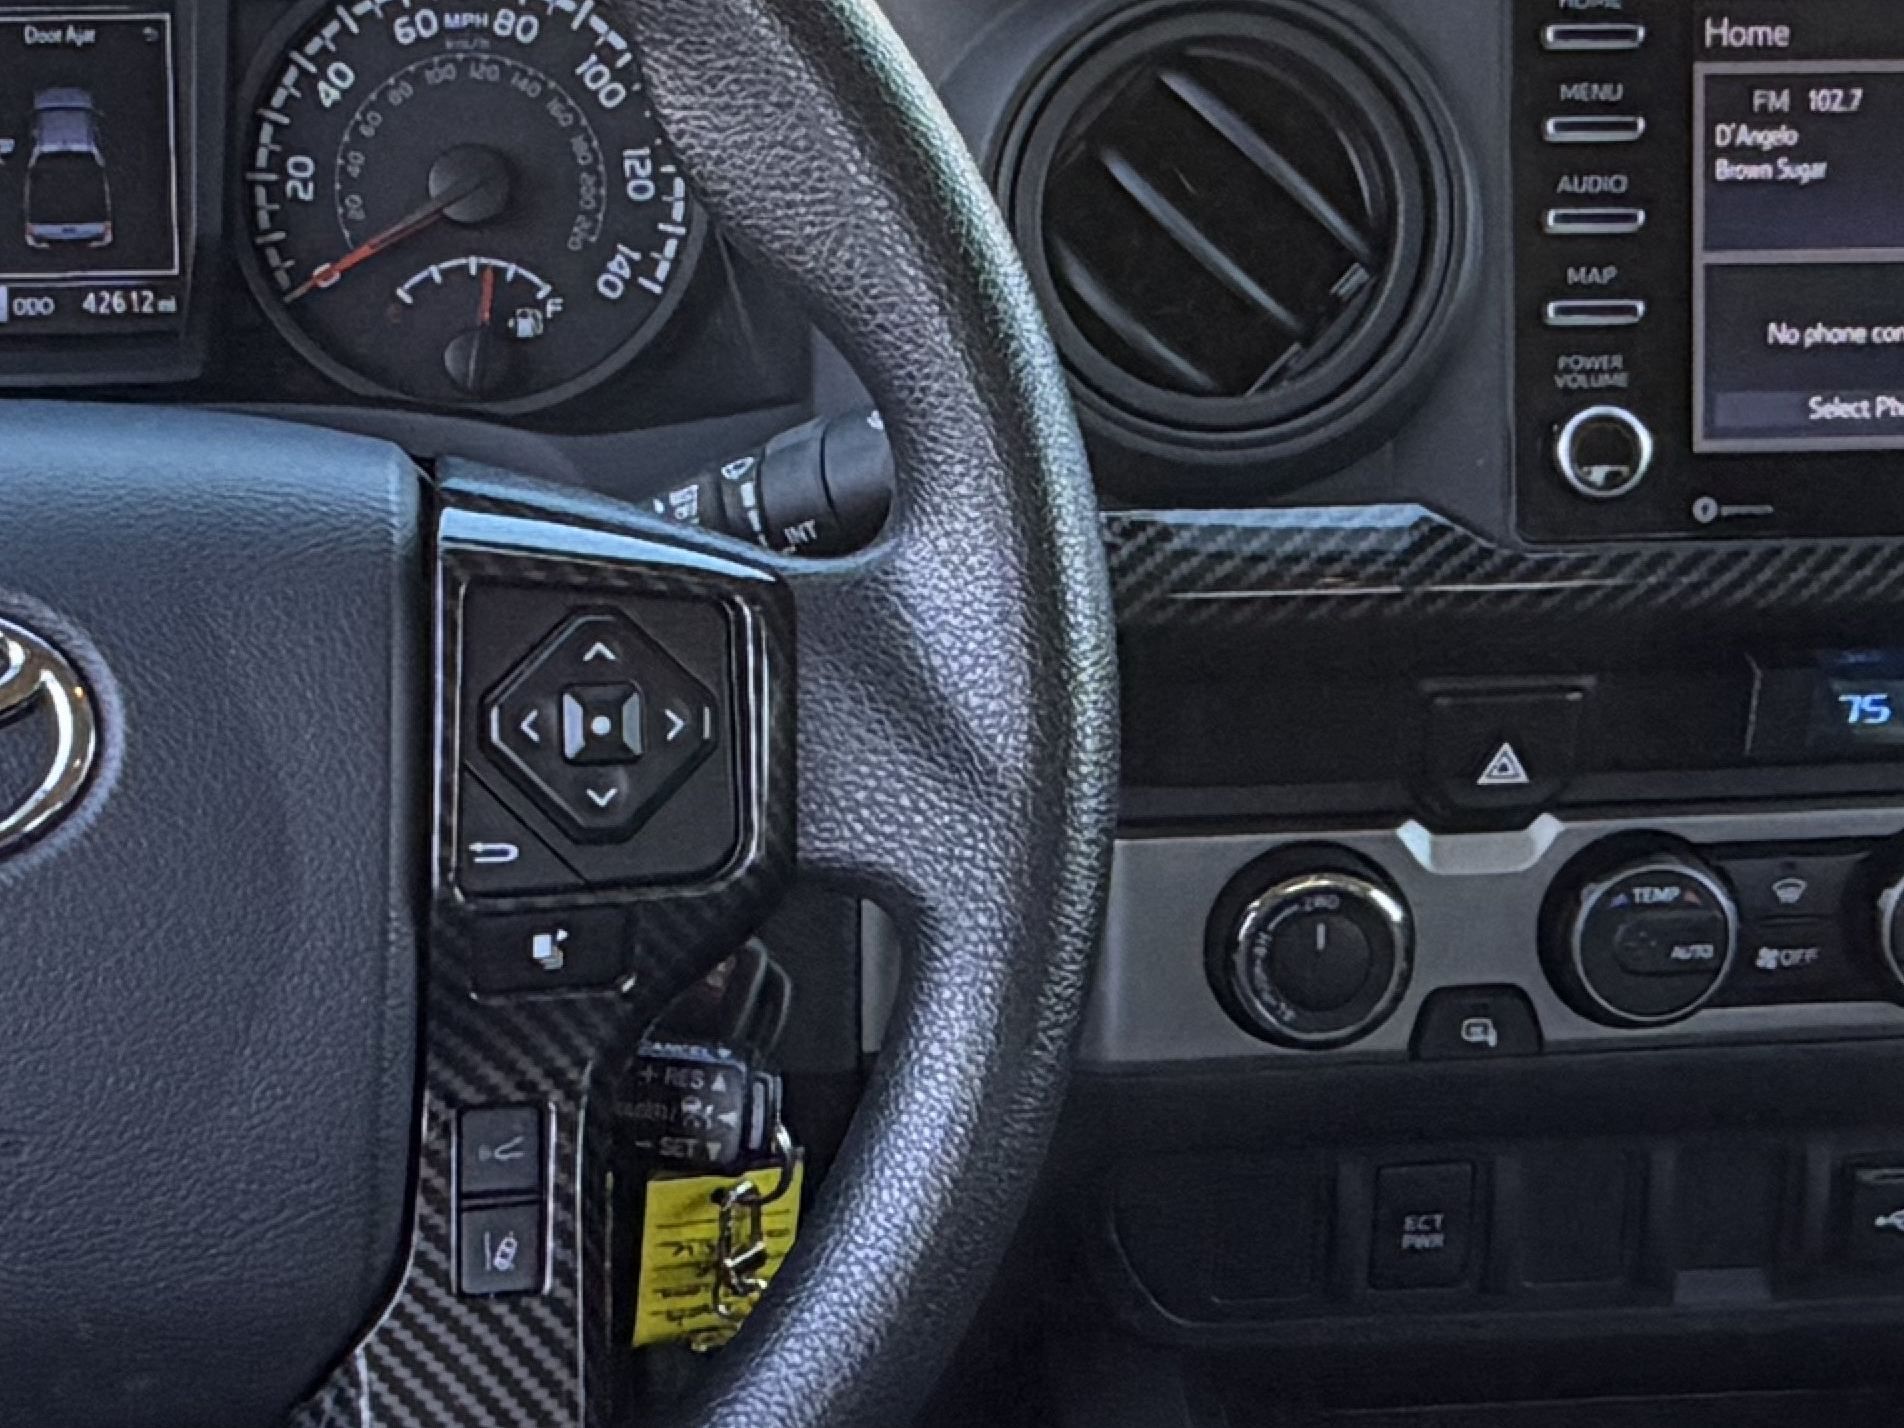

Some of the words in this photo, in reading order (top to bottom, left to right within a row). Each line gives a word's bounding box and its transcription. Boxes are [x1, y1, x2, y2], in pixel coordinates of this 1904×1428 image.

[393, 8, 439, 46] 60
[443, 12, 490, 29] MPH
[492, 8, 539, 44] 80
[1704, 16, 1791, 48] Home
[24, 24, 63, 45] Door
[65, 24, 96, 47] Ajar
[316, 61, 356, 109] 40
[574, 53, 628, 110] 100
[1559, 81, 1624, 102] MENU
[1752, 88, 1791, 113] FM
[1808, 86, 1864, 112] 102.7
[285, 154, 316, 202] 20
[622, 146, 656, 202] 120
[1715, 157, 1774, 181] Brown
[1777, 156, 1828, 185] Sugar
[1557, 174, 1629, 194] AUDIO
[596, 243, 643, 300] 140
[1567, 265, 1618, 285] MAP
[81, 290, 155, 315] 42612
[546, 297, 564, 319] F
[1767, 322, 1800, 345] No
[1804, 322, 1868, 349] phone
[1558, 354, 1624, 371] POWER
[1554, 372, 1629, 389] VOLUME
[1808, 395, 1871, 420] Select
[1838, 693, 1891, 724] 75
[1632, 886, 1681, 904] TEMP
[1670, 944, 1715, 960] AUTO
[1780, 947, 1821, 967] OFF
